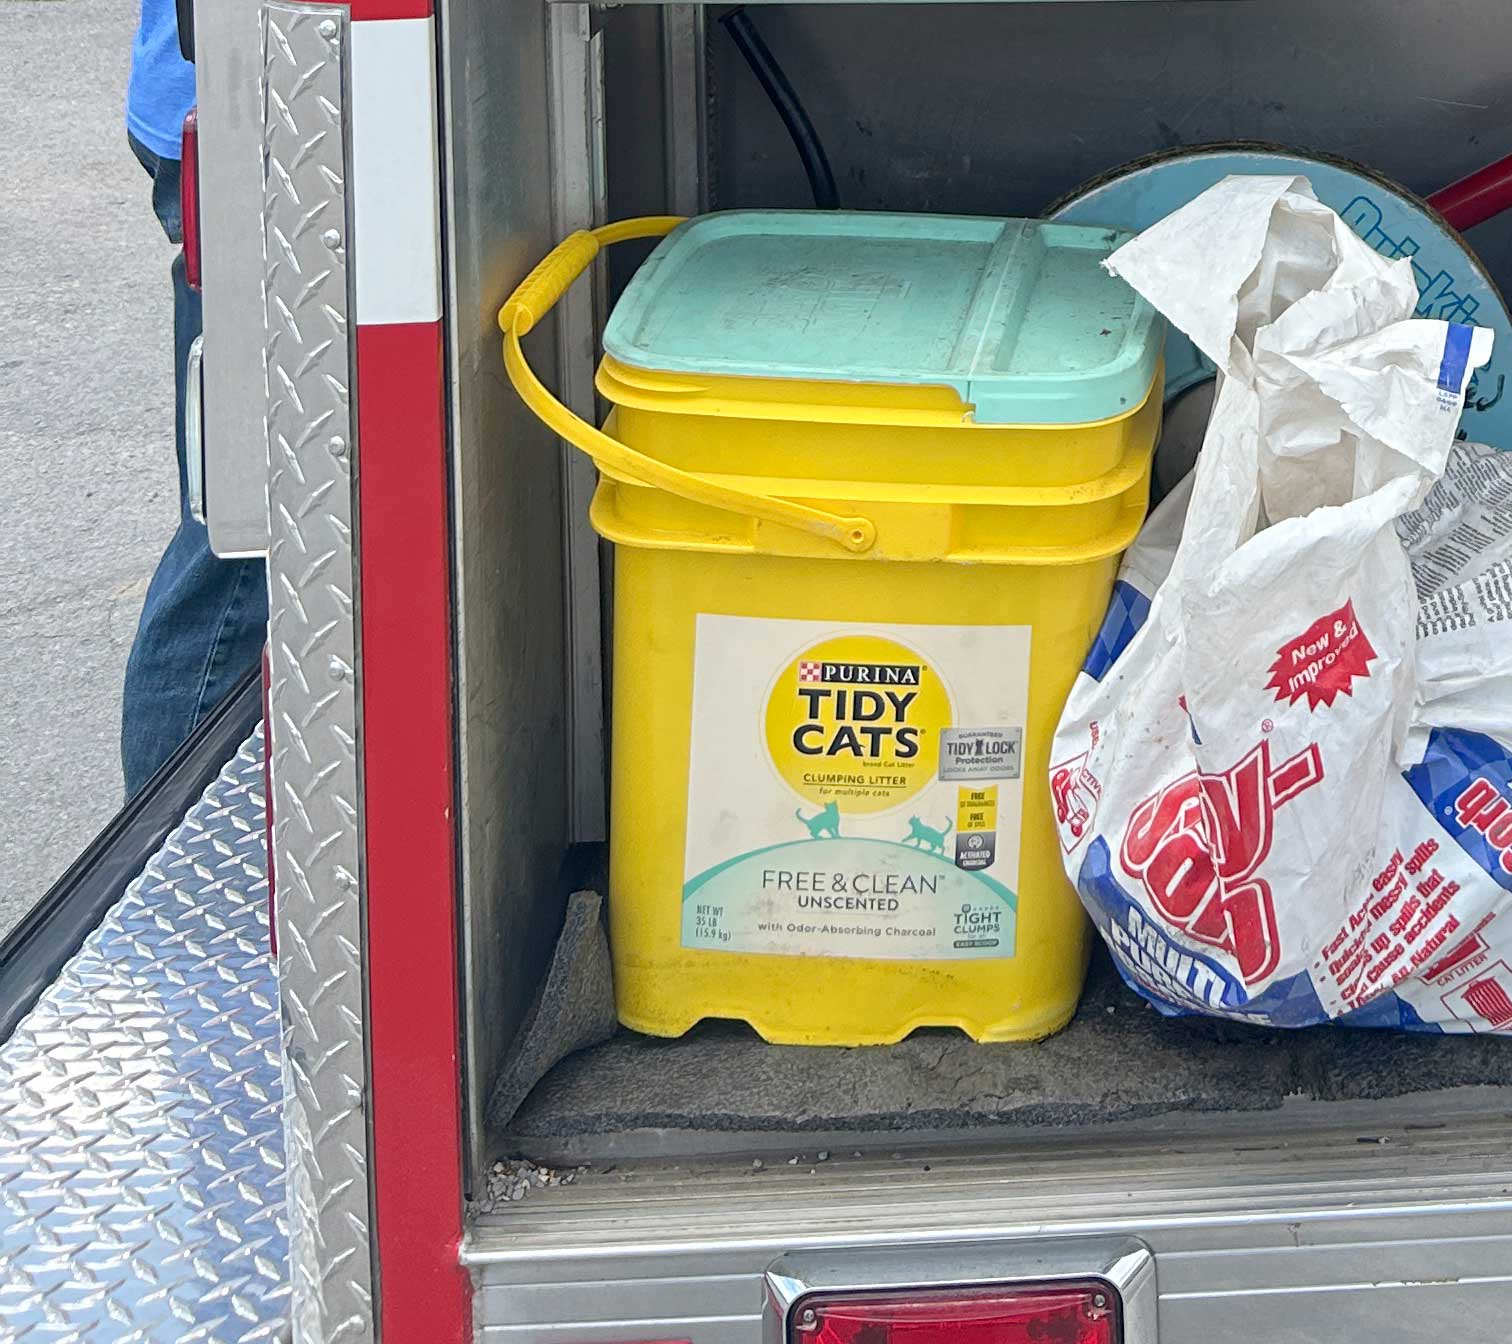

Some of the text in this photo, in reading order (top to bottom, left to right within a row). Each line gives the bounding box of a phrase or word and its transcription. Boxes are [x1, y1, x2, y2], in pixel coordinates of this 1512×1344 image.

[1292, 620, 1347, 666] New &
[1288, 621, 1359, 692] Improved
[824, 665, 916, 683] PURINA
[798, 688, 918, 722] TIDY
[793, 724, 918, 758] CATS
[947, 741, 1016, 756] TIDY LOCK
[955, 756, 1004, 765] Protection
[803, 773, 906, 785] CLUMPING LITTER
[819, 787, 832, 795] for
[835, 787, 869, 797] multiple
[1405, 837, 1440, 875] spills
[763, 870, 937, 894] FREE & CLEAN
[798, 896, 899, 911] UNSCENTED
[1369, 871, 1409, 921] messy
[696, 916, 717, 927] 35 LB
[697, 904, 723, 917] NET WT
[954, 912, 1001, 924] TIGHT
[1370, 868, 1446, 954] up spills that
[719, 929, 731, 941] kg)
[758, 922, 936, 937] with Odor-Absorbing Charcoal
[954, 924, 1000, 934] CLUMPS
[1366, 880, 1461, 984] cause accidents
[1409, 913, 1461, 967] Natural
[1321, 927, 1349, 960] Fast
[1128, 905, 1226, 1008] MULTI
[1436, 954, 1488, 987] CAT LITTER
